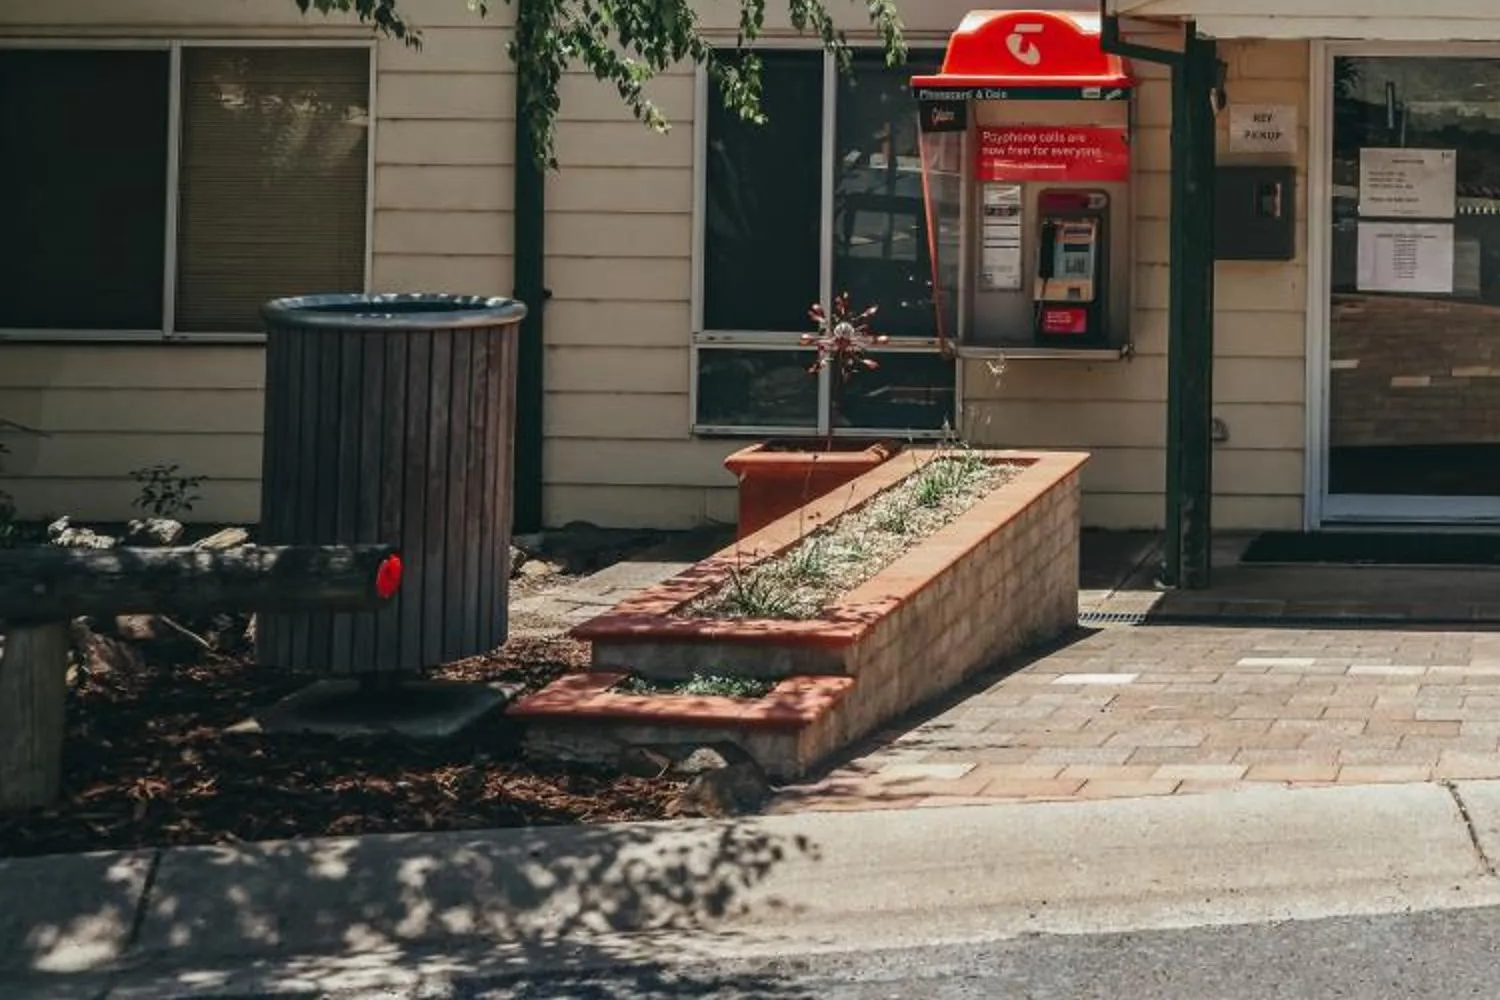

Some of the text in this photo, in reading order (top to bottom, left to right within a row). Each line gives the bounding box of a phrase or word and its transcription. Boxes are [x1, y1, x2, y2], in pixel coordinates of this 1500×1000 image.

[983, 131, 1086, 144] Payphone calls are
[982, 147, 1005, 155] now
[1007, 145, 1031, 155] free
[1033, 145, 1049, 155] for
